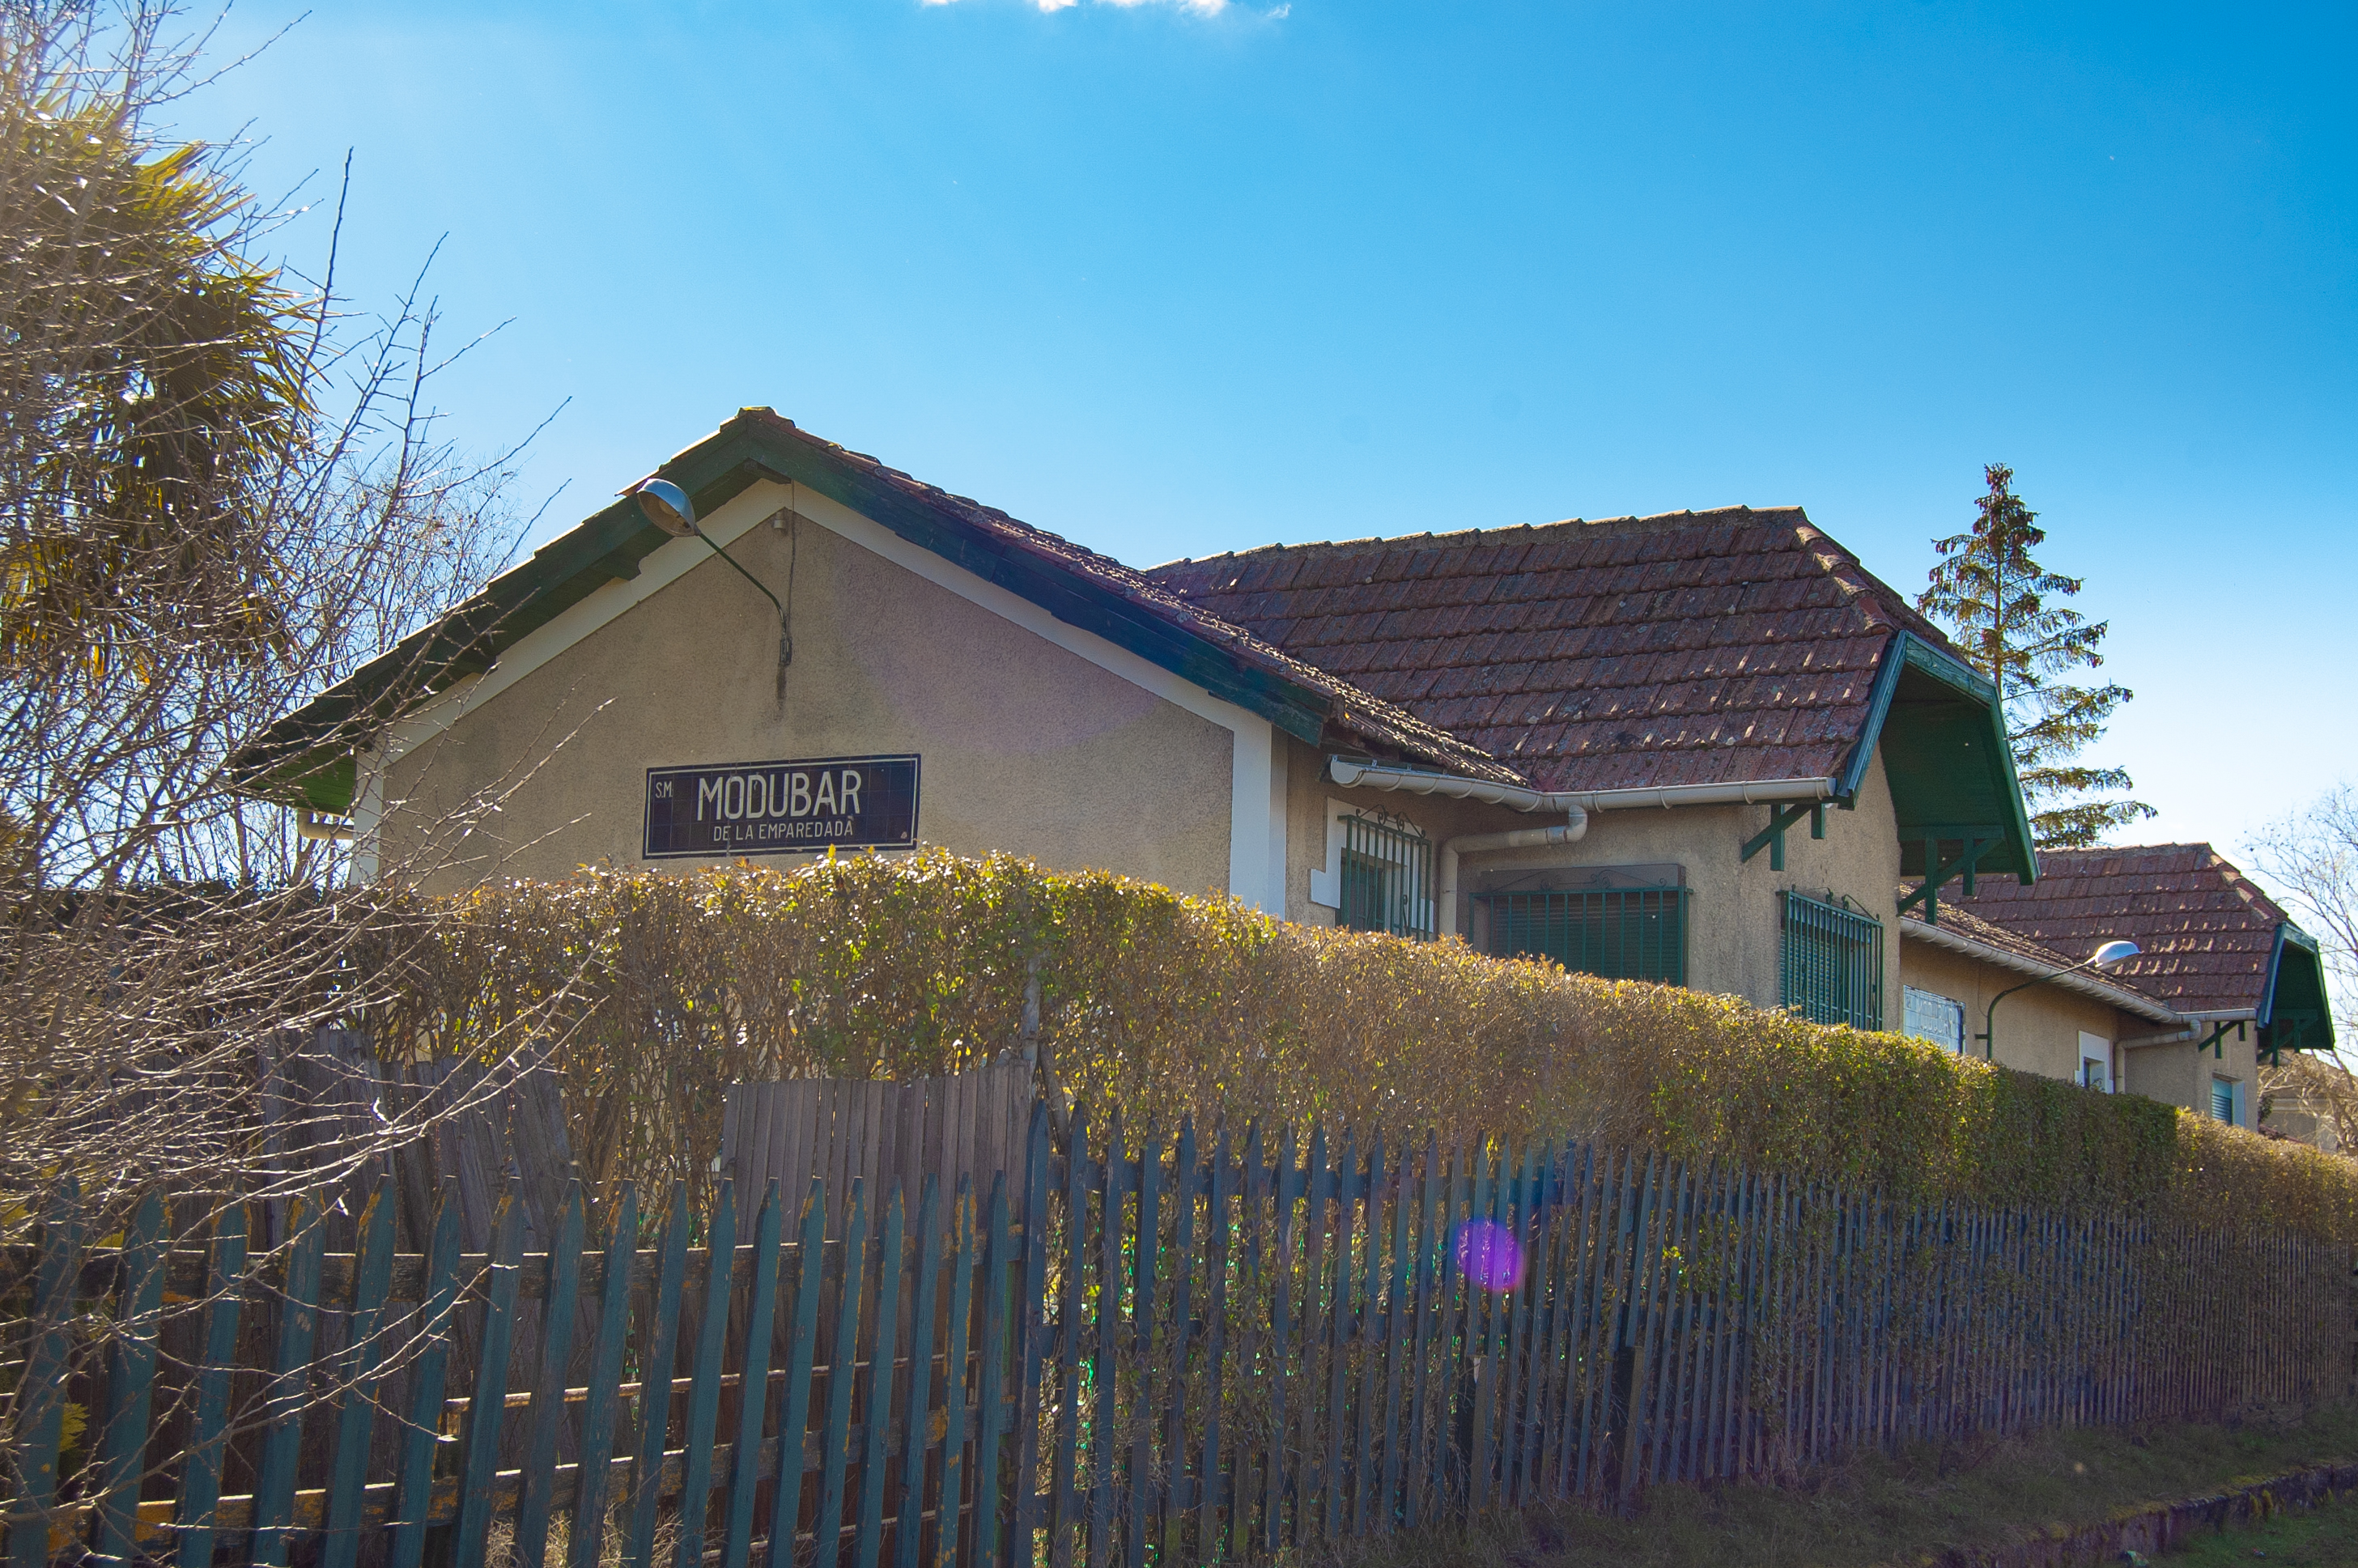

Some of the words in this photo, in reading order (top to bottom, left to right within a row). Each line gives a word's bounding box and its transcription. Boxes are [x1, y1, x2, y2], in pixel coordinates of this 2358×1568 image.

[697, 770, 862, 822] MODUBAR
[713, 825, 732, 842] DE
[736, 824, 754, 841] LA
[758, 820, 853, 840] EMPAREDADA
